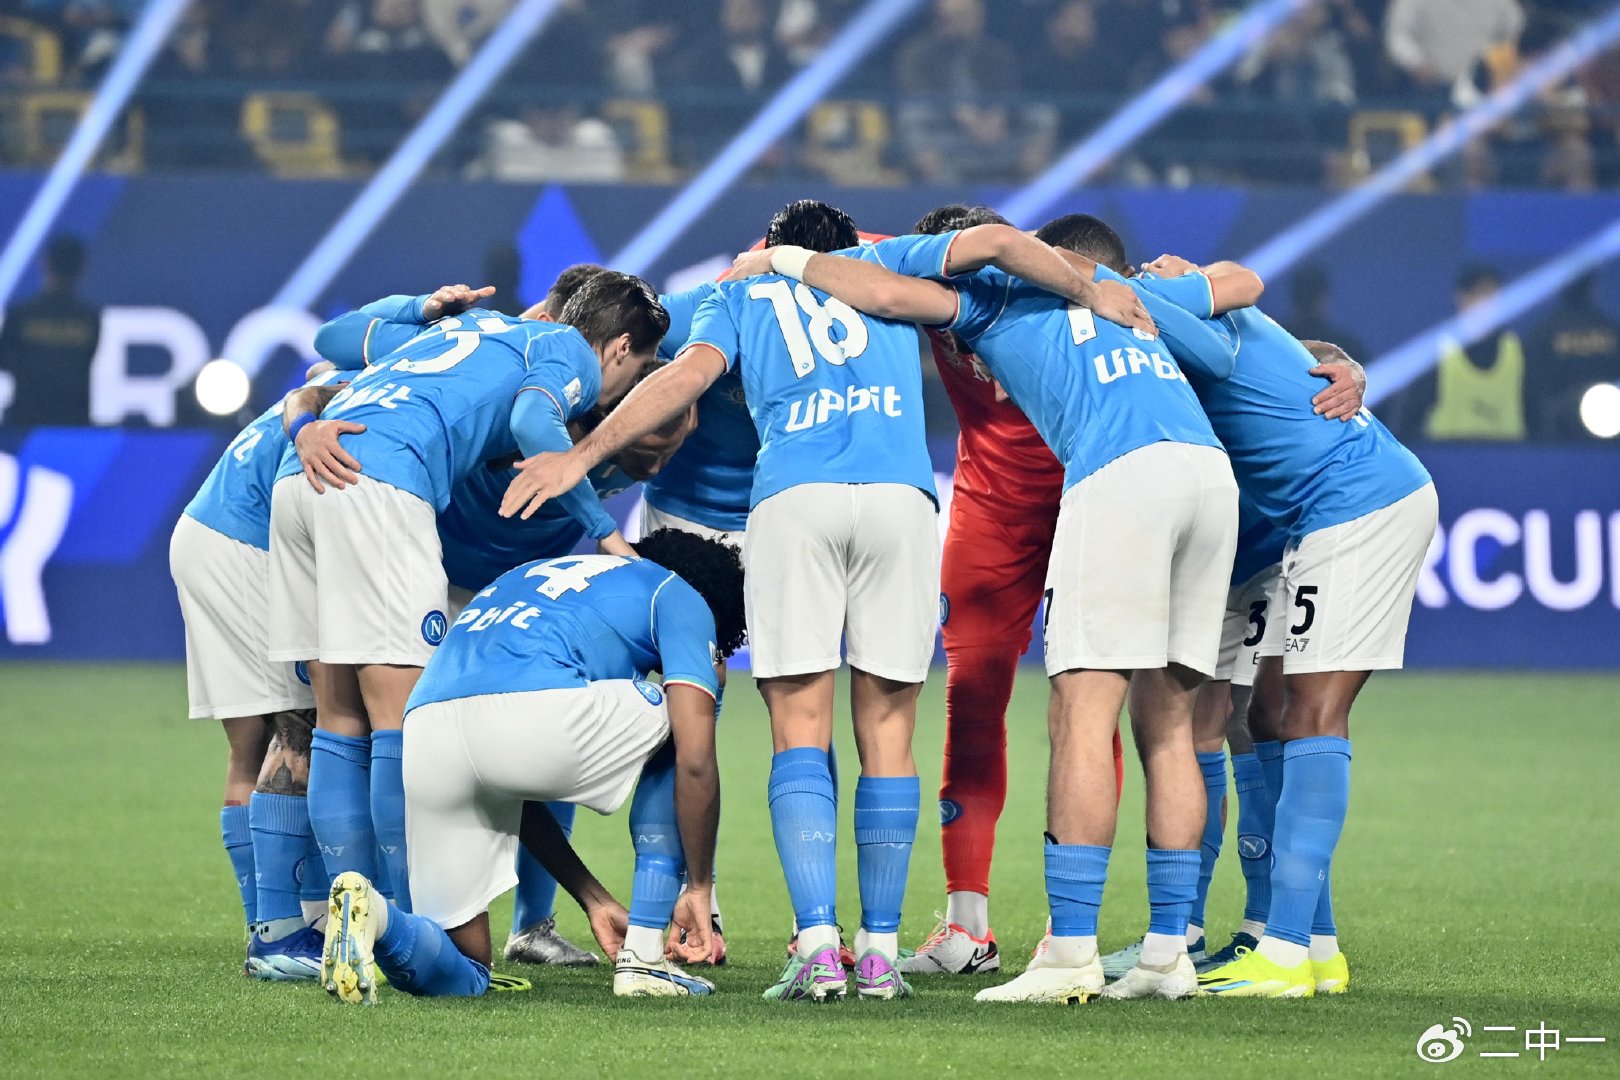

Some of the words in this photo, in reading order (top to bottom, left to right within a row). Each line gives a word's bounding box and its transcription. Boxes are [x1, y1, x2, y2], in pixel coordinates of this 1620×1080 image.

[749, 279, 869, 379] 18
[1291, 585, 1318, 635] 5
[1285, 638, 1310, 652] EA7
[801, 830, 834, 843] EA7
